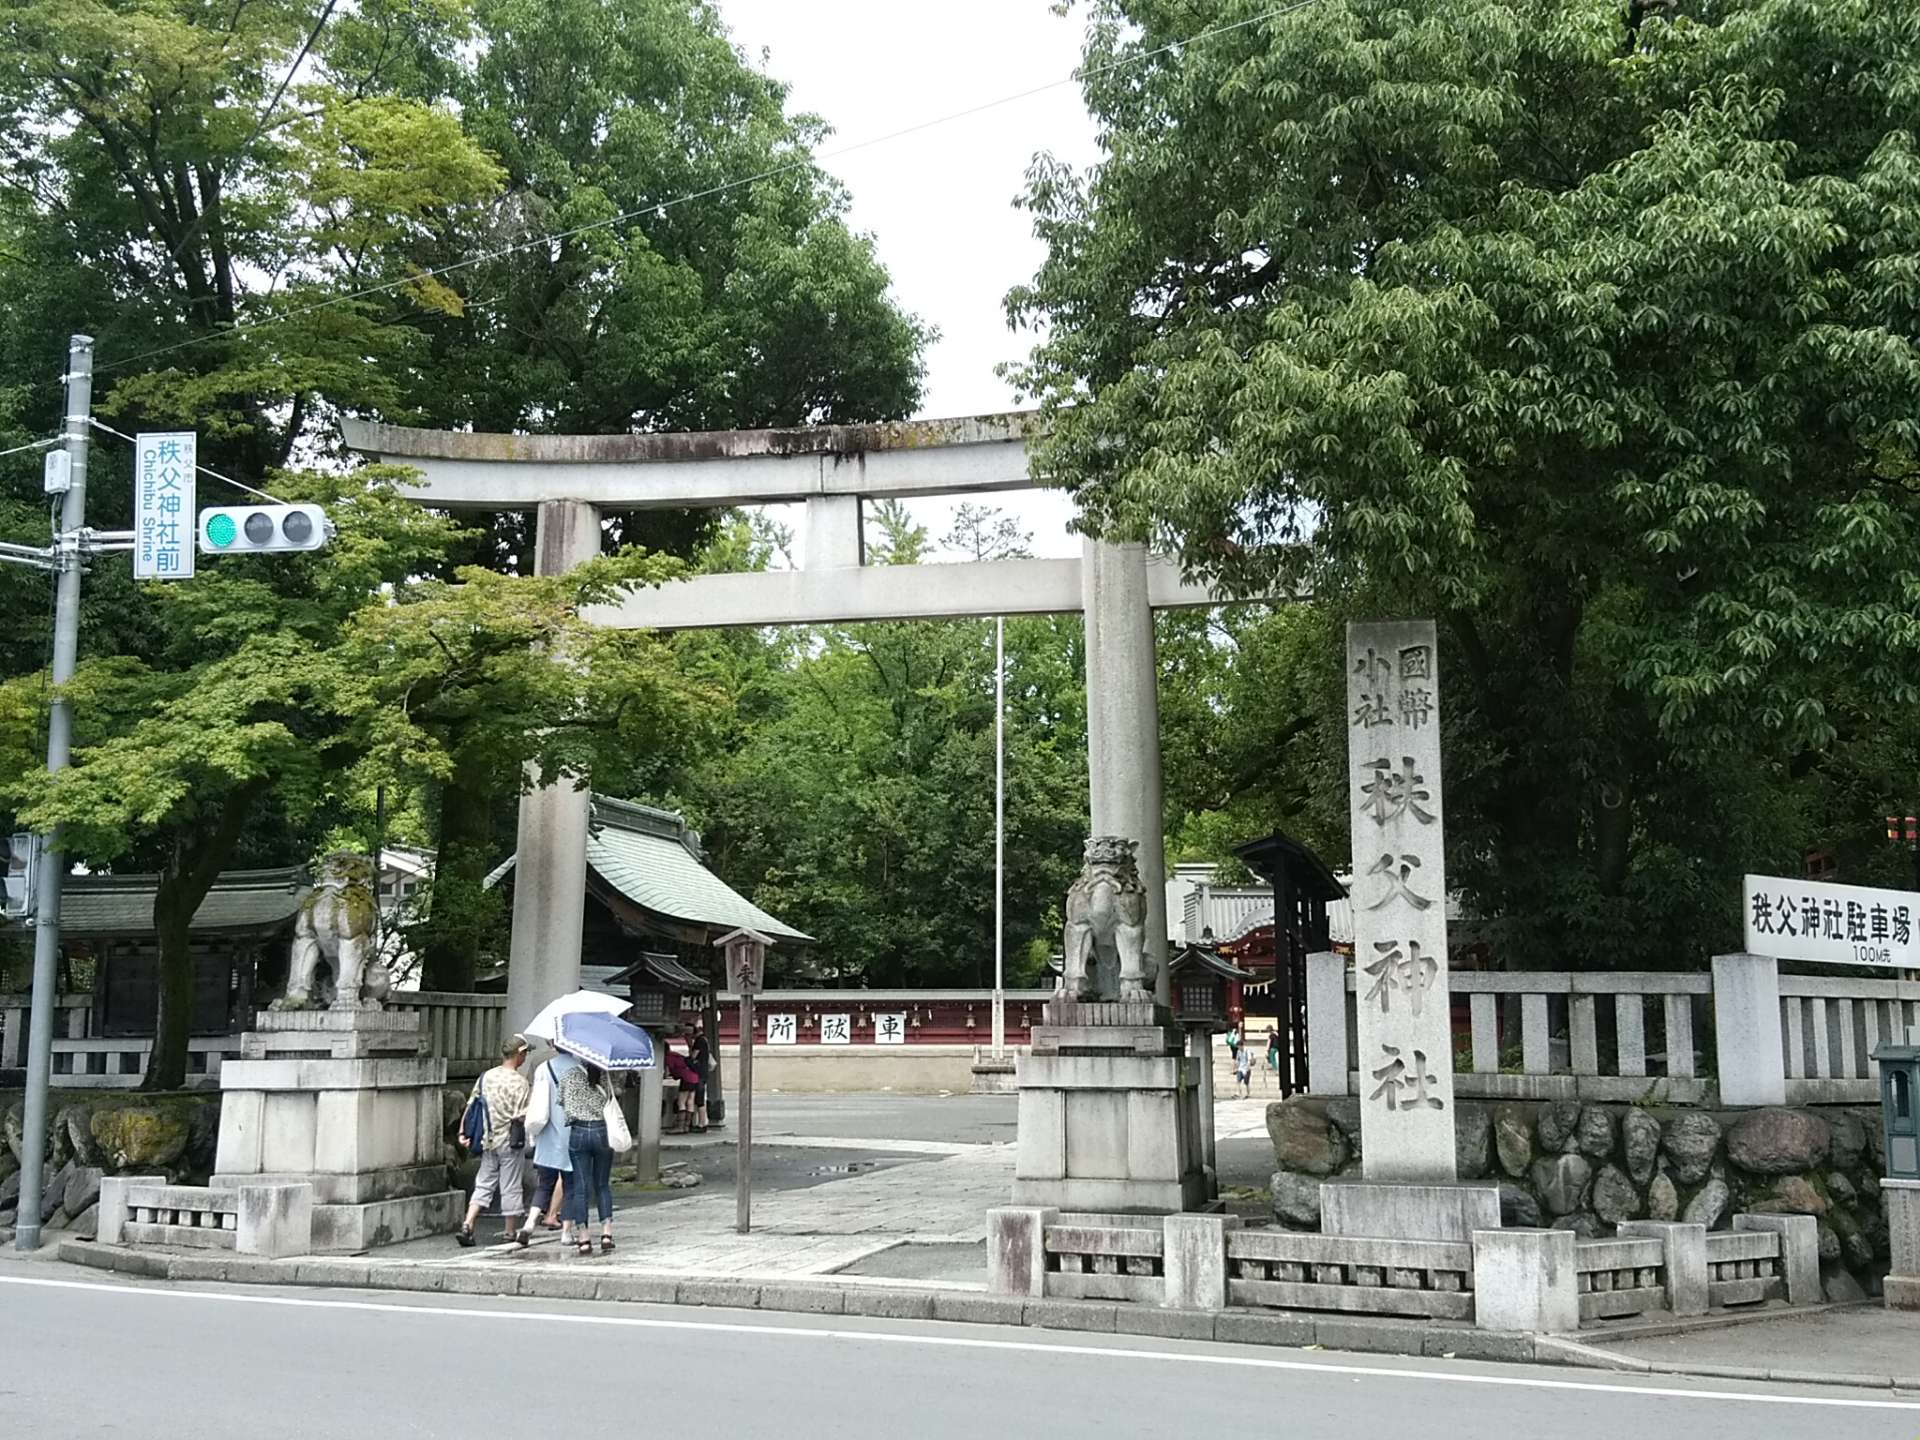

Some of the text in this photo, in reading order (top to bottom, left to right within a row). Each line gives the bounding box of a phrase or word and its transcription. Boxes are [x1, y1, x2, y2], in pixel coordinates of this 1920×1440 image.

[143, 449, 156, 562] Chichibu Shrine
[157, 440, 181, 572] 秩父神社前
[1352, 647, 1393, 729] 小社
[1360, 756, 1444, 1112] 秩父神社
[1752, 893, 1911, 945] 秩父神社駐車場
